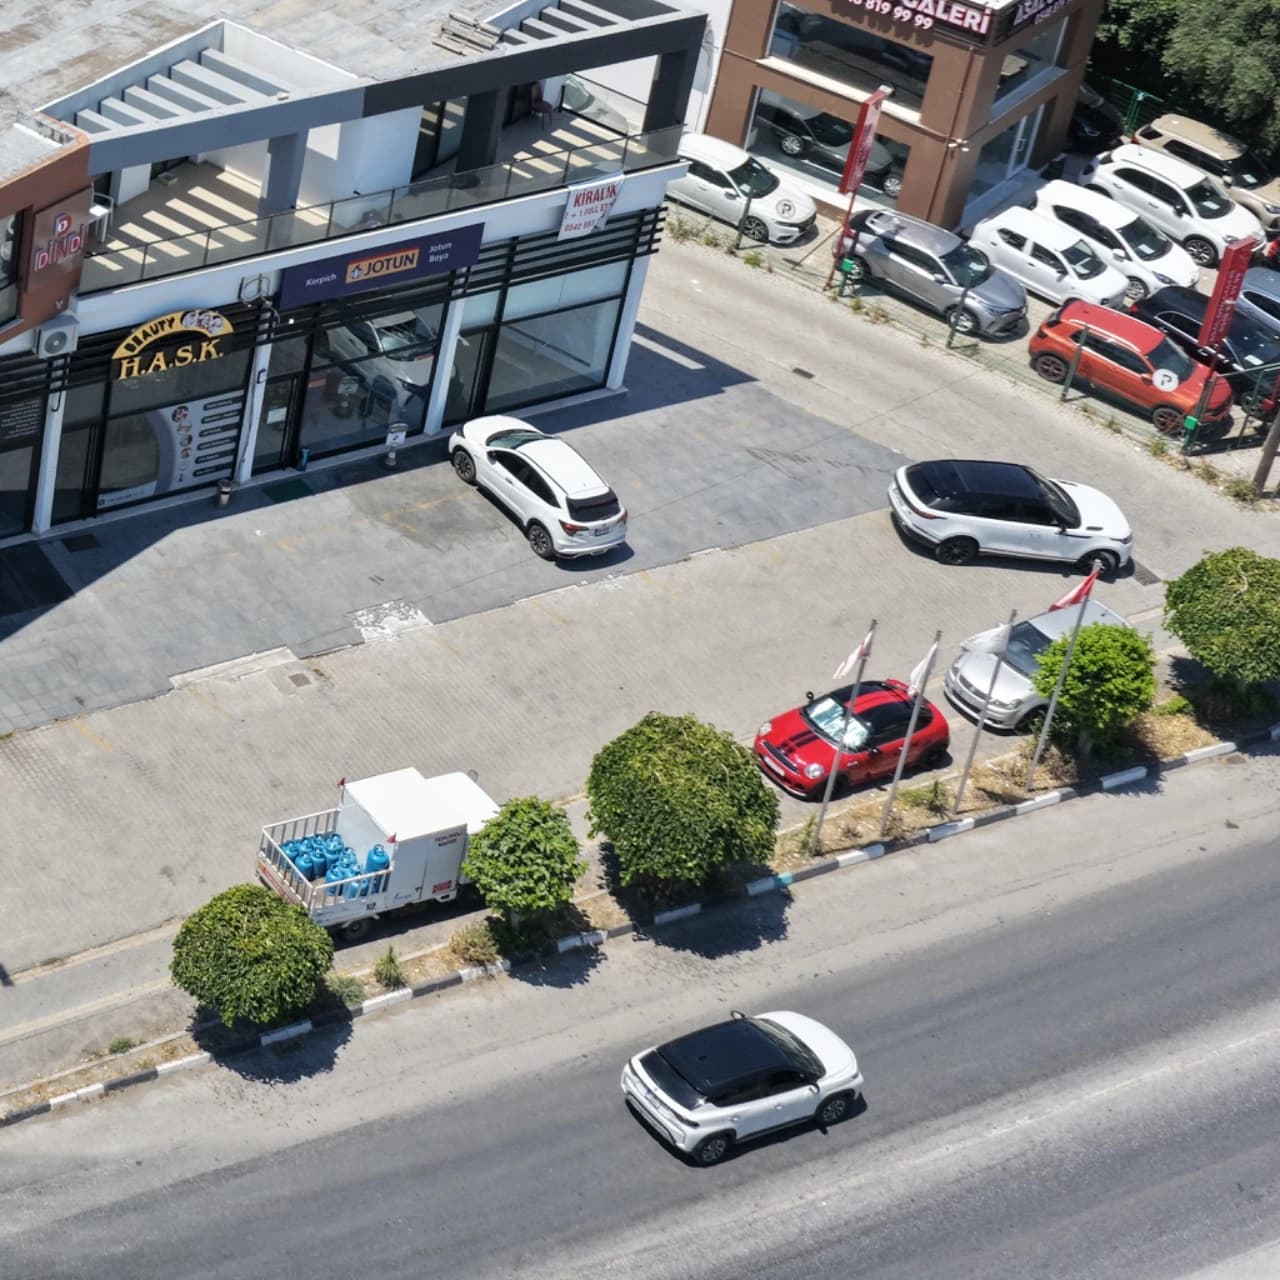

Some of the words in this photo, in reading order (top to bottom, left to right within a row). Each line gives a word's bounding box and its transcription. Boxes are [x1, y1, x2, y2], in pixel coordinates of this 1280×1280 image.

[893, 6, 913, 23] 99
[914, 13, 934, 31] 99
[428, 241, 452, 254] Jotun
[364, 253, 416, 276] JOTUN
[428, 252, 449, 264] Boya
[306, 273, 337, 287] Kerpich
[123, 316, 177, 353] BEAUTY
